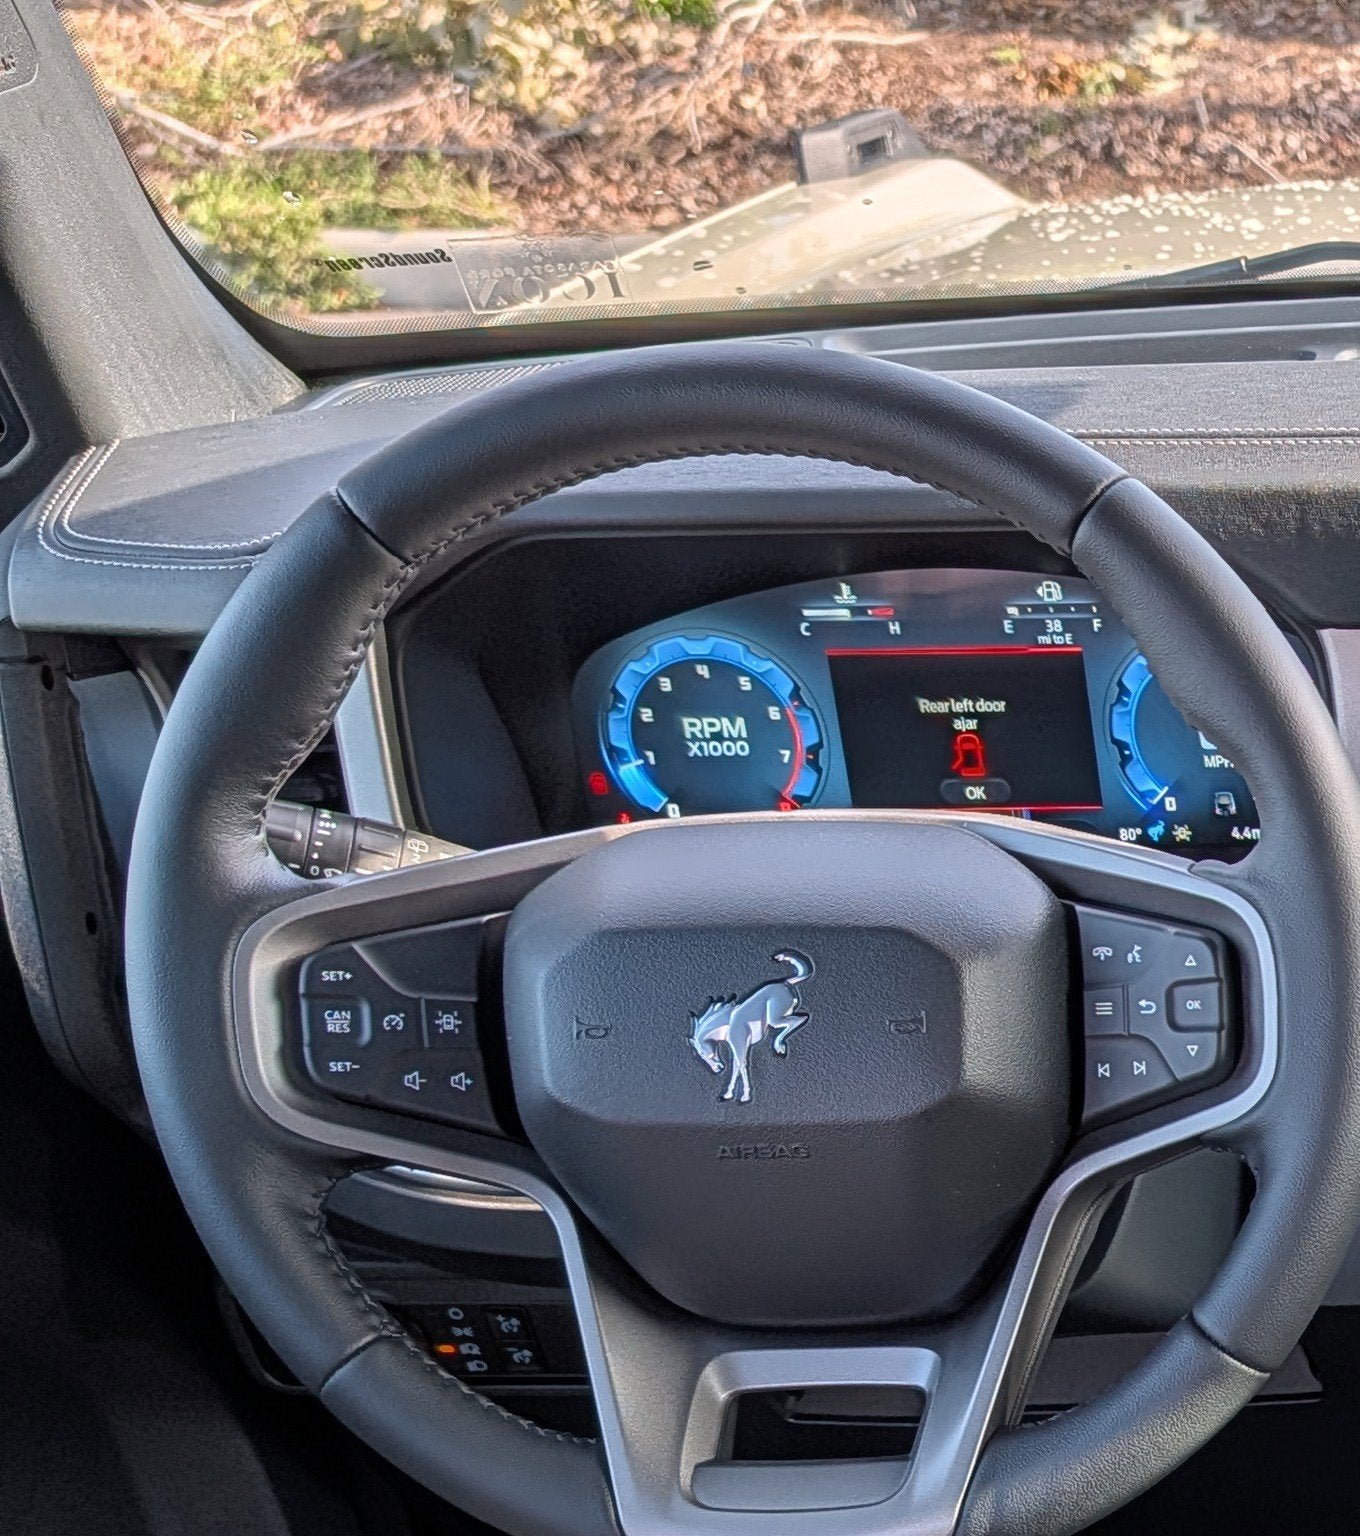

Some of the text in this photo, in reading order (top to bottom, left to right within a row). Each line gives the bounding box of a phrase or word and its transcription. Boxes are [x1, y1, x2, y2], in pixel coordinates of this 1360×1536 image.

[801, 622, 812, 636] C
[889, 622, 899, 635] H
[1003, 620, 1014, 634] E
[1045, 619, 1063, 632] 38
[1093, 619, 1102, 632] F
[1038, 633, 1073, 645] mi to E
[695, 664, 710, 679] 4
[657, 677, 672, 692] 3
[738, 676, 752, 691] 5
[767, 706, 780, 720] 6
[917, 698, 1006, 714] Rear left door
[639, 707, 654, 722] 2
[682, 717, 748, 739] RPM
[953, 716, 978, 732] ajar
[686, 741, 750, 757] X1000
[644, 751, 656, 766] 1
[780, 750, 790, 764] 7
[965, 786, 987, 800] OK
[667, 803, 681, 818] 0
[1186, 1000, 1202, 1010] OK
[324, 1010, 351, 1021] CAN
[326, 1023, 351, 1034] RES
